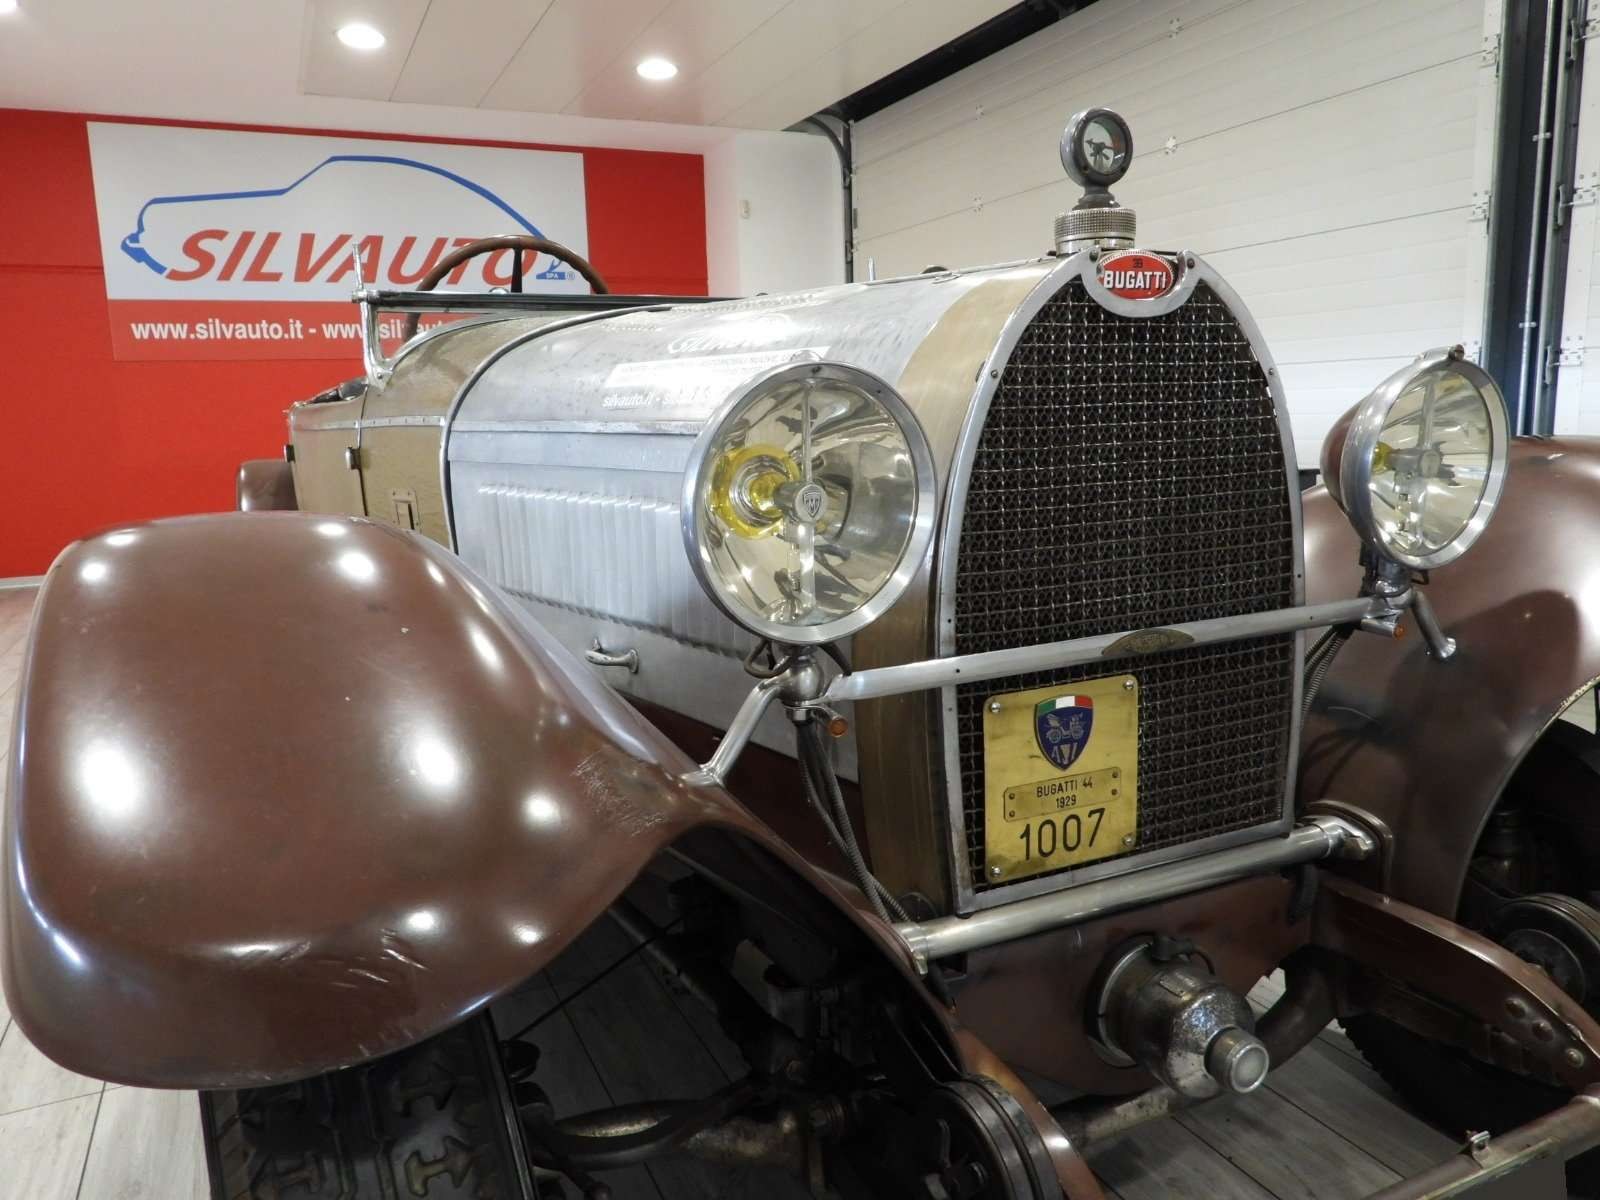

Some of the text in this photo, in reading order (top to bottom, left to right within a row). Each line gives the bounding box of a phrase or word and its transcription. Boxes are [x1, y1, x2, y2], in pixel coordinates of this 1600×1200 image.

[166, 228, 538, 286] SILVAUTO
[1104, 270, 1166, 288] BUGATTI
[130, 319, 304, 341] www.silvauto.it
[1036, 777, 1093, 798] BUGATTI 44
[1055, 794, 1077, 808] 1929
[1019, 808, 1106, 861] 1007
